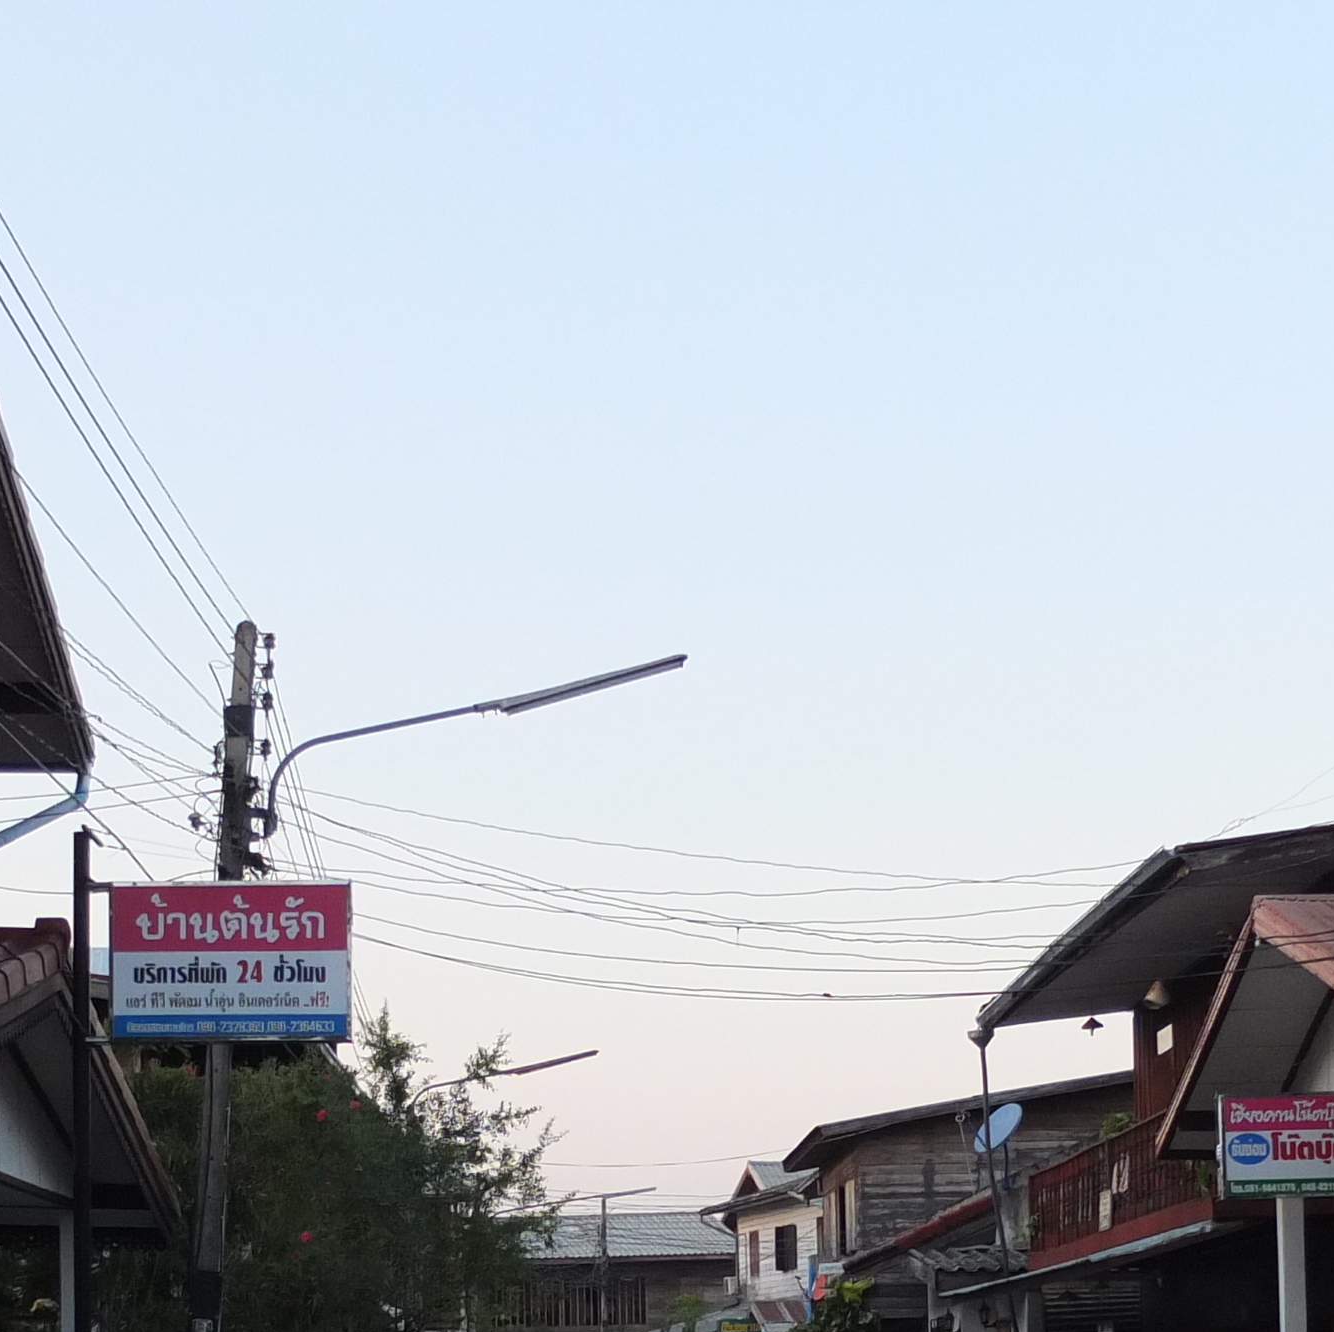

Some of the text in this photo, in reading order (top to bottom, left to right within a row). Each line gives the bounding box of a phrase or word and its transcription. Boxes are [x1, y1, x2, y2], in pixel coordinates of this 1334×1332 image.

[135, 892, 326, 944] บ้านต้นรัก
[133, 954, 326, 984] บริการที่พัก 24 ชั่วโมง
[126, 993, 147, 1009] แอร์
[168, 993, 201, 1009] พัดลม
[204, 988, 234, 1012] น้ำอุ่น
